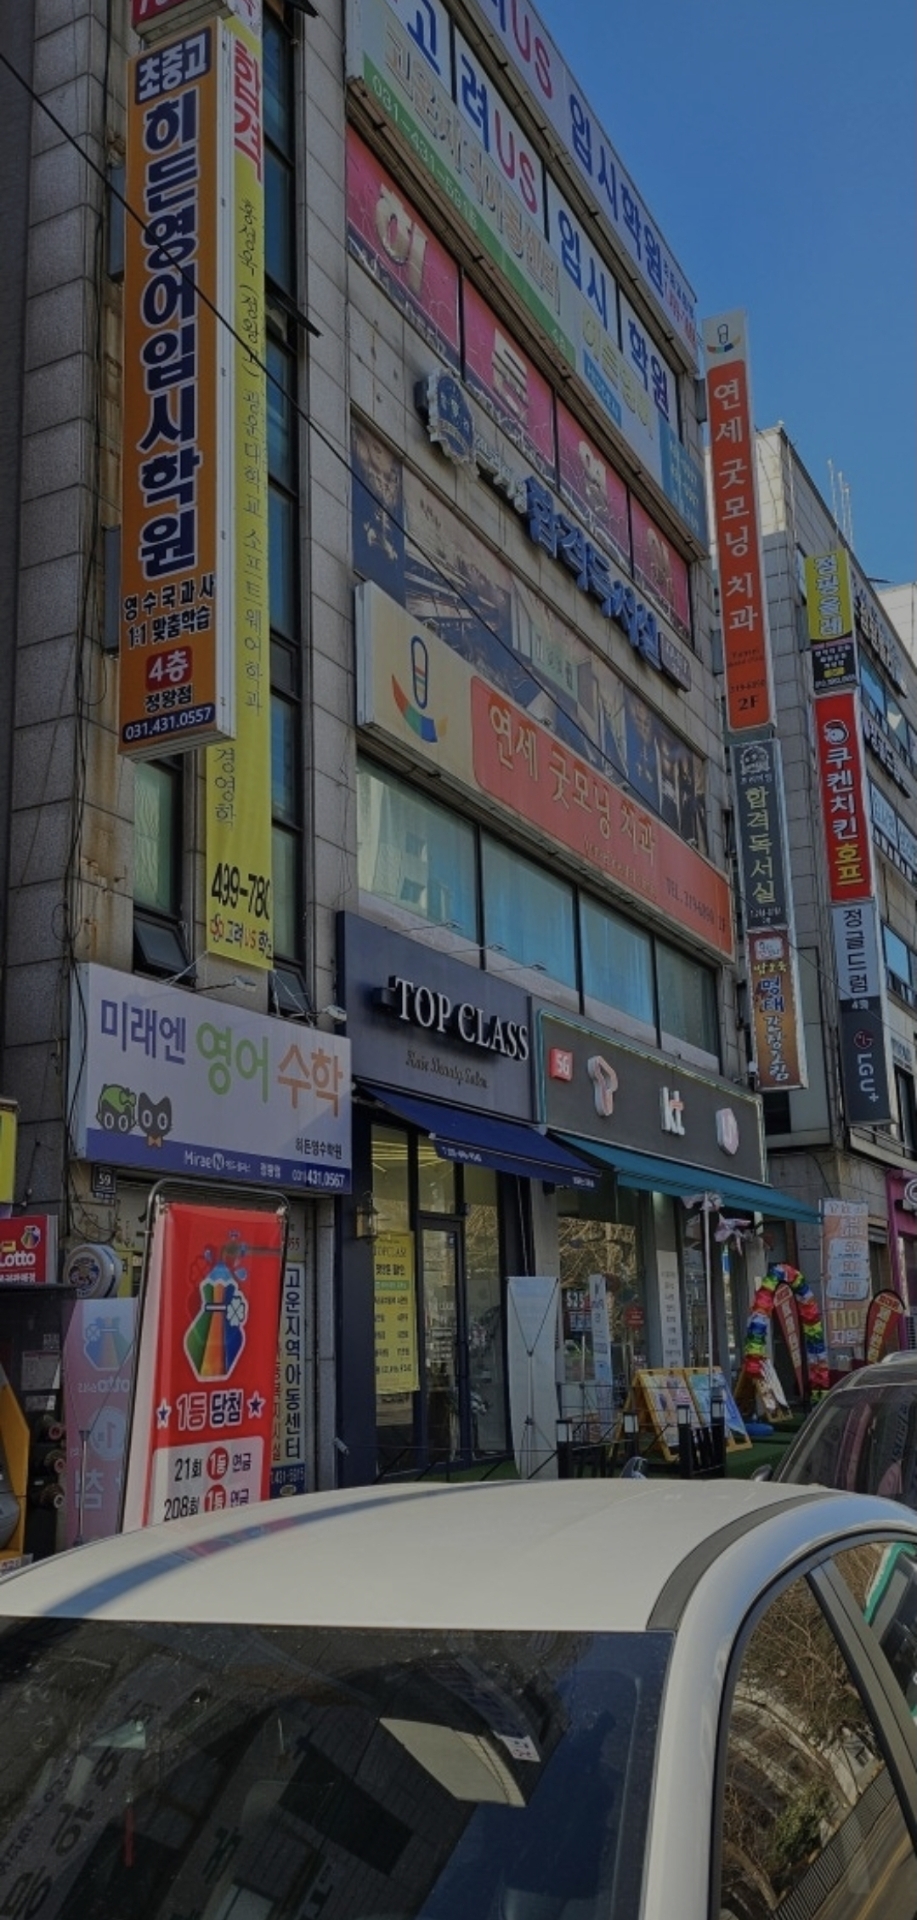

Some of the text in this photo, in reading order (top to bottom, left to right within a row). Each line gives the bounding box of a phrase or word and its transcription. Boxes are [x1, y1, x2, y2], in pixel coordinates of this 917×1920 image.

[139, 33, 206, 101] 초중고
[233, 39, 262, 183] 합격
[567, 93, 665, 298] 입시학원
[140, 88, 203, 580] 히든영어입시학원
[714, 377, 743, 444] 연세
[718, 458, 750, 557] 굿모닝
[524, 475, 660, 670] 합격독서실
[726, 571, 758, 633] 치과
[128, 605, 212, 649] 1:1 맞춤학습
[145, 684, 193, 713] 정왕점
[149, 650, 190, 683] 4층
[125, 704, 213, 740] 031.431.0557
[738, 694, 758, 712] 2F
[213, 747, 237, 831] 경영학
[489, 705, 540, 782] 연세
[548, 750, 613, 841] 굿모닝
[620, 798, 657, 866] 치과
[744, 785, 777, 905] 합격독서실
[844, 908, 869, 994] 정글드럼
[395, 977, 530, 1061] TOP CLASS
[761, 976, 784, 1012] 명태
[101, 999, 344, 1119] 미래엔 영어 수학
[659, 1085, 686, 1136] kt
[98, 1172, 112, 1186] 59
[285, 1267, 301, 1459] 고운지역아동센터
[175, 1387, 245, 1432] 1등 당첨
[174, 1457, 203, 1482] 21회
[231, 1452, 252, 1473] 연금
[164, 1494, 200, 1522] 208회
